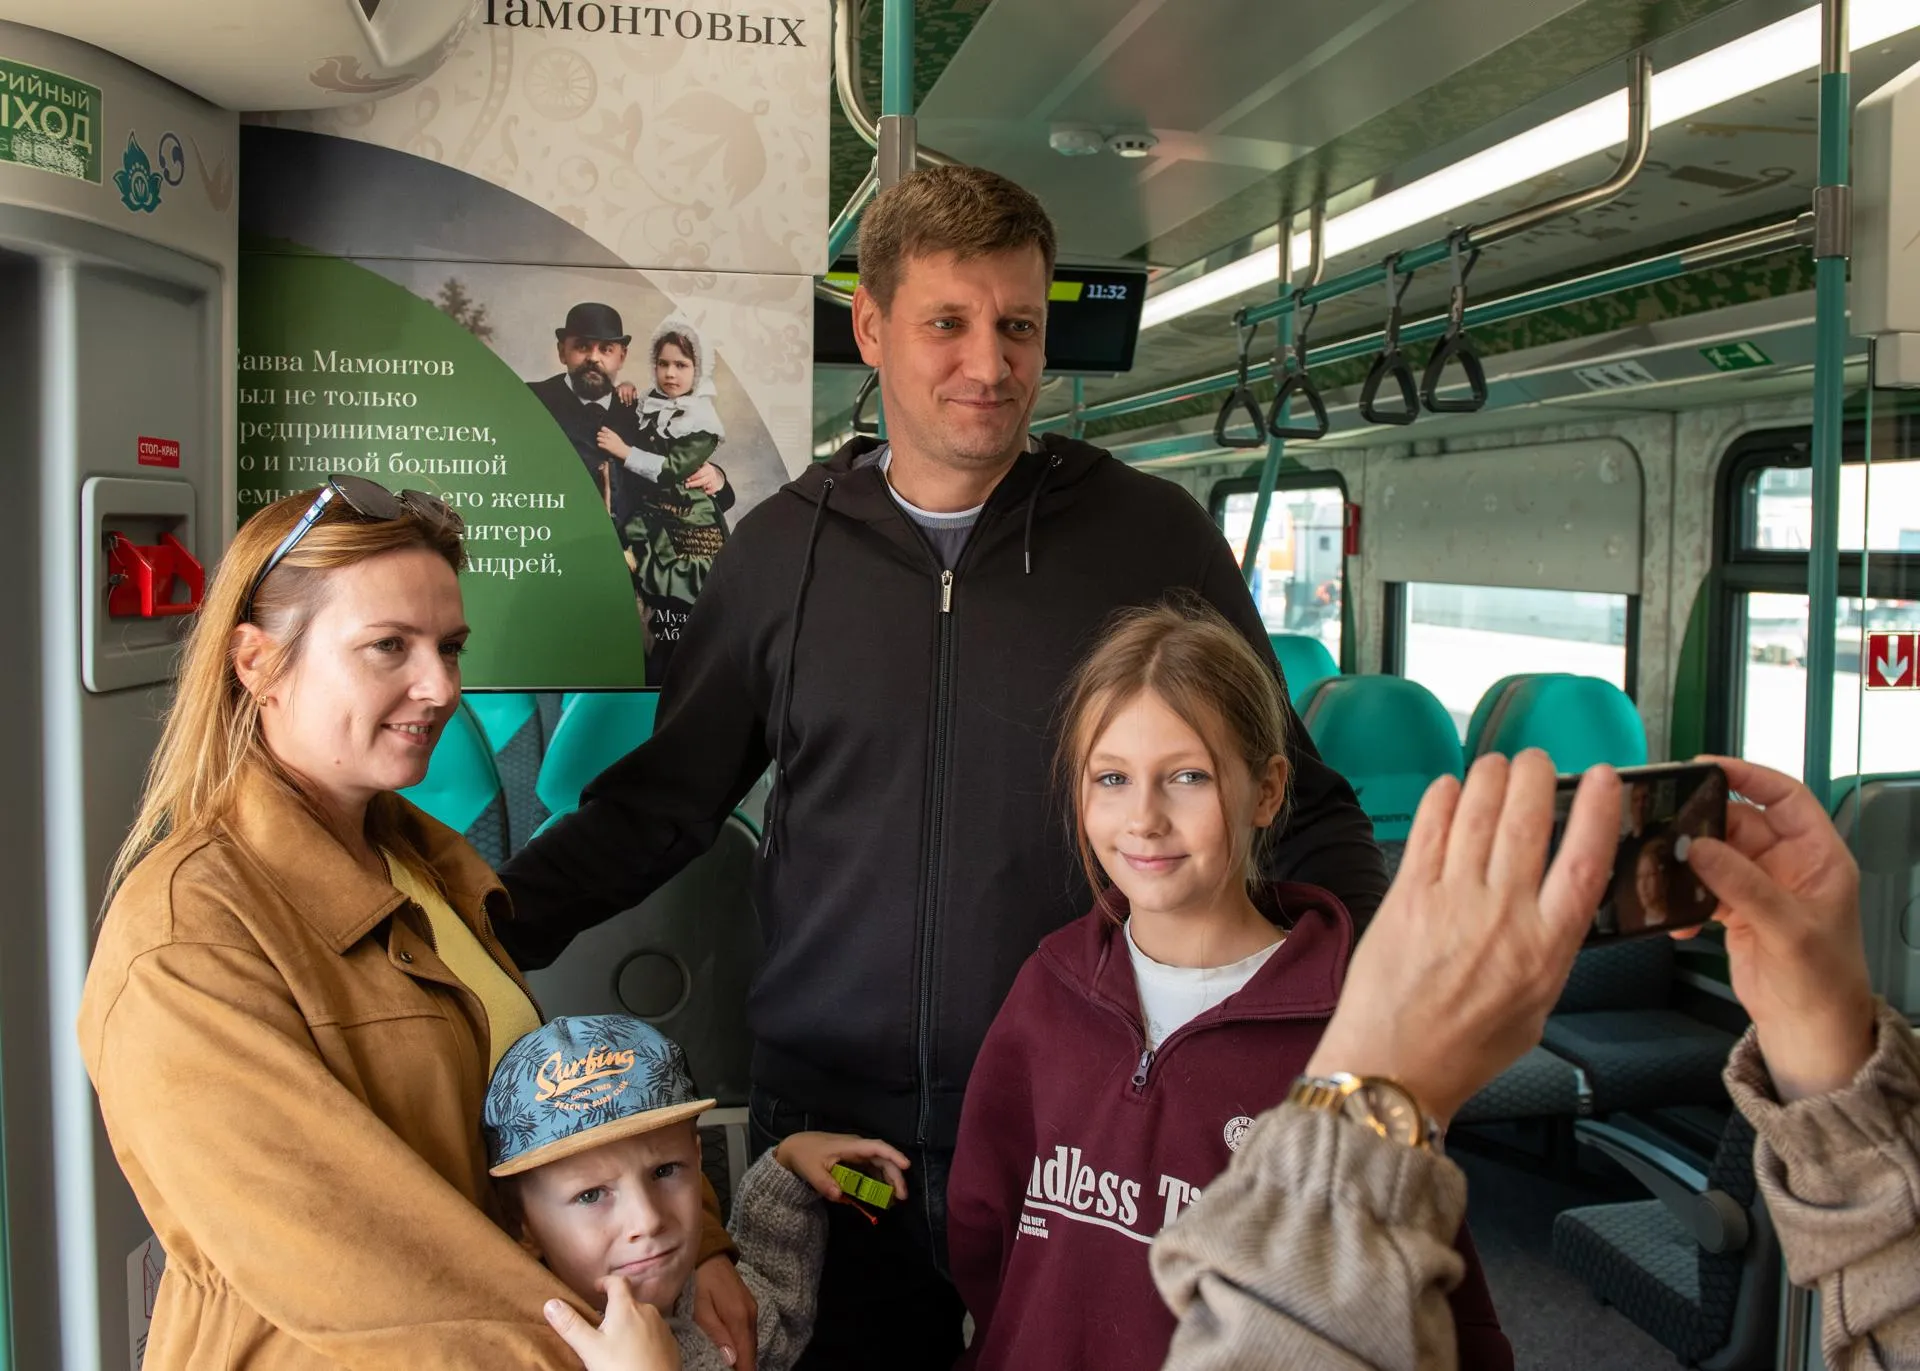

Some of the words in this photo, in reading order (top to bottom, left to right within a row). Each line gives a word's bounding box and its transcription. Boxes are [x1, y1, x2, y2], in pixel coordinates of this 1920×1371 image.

[1087, 284, 1128, 299] 11:32
[238, 347, 304, 372] авва
[312, 349, 455, 376] Мамонтов
[285, 389, 316, 405] не
[323, 390, 418, 408] только
[140, 442, 178, 457] СТОП-КРАН
[264, 455, 279, 471] и
[288, 451, 381, 473] главой
[388, 450, 507, 475] большой
[491, 492, 566, 509] жены
[656, 609, 690, 627] Муз
[535, 1044, 636, 1102] Surfing
